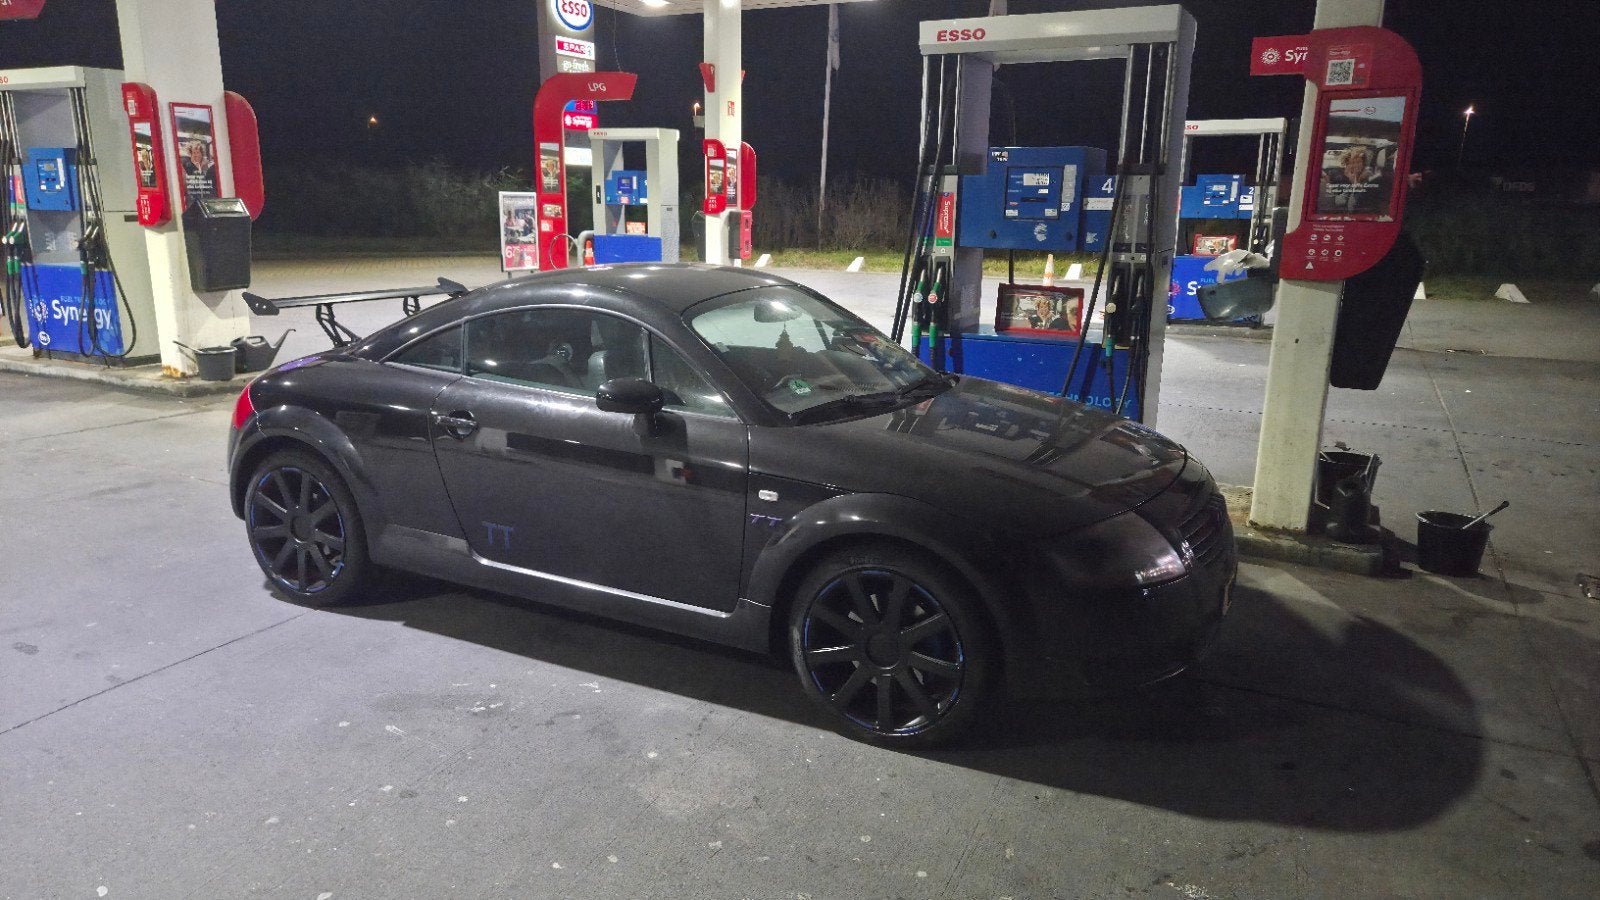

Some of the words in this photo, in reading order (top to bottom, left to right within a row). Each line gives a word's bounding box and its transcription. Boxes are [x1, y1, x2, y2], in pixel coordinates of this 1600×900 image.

[936, 27, 986, 41] ESSO
[587, 82, 607, 92] LPG
[1101, 177, 1114, 194] 4
[1248, 186, 1255, 195] 2
[751, 513, 783, 526] TT
[481, 520, 515, 551] TT
